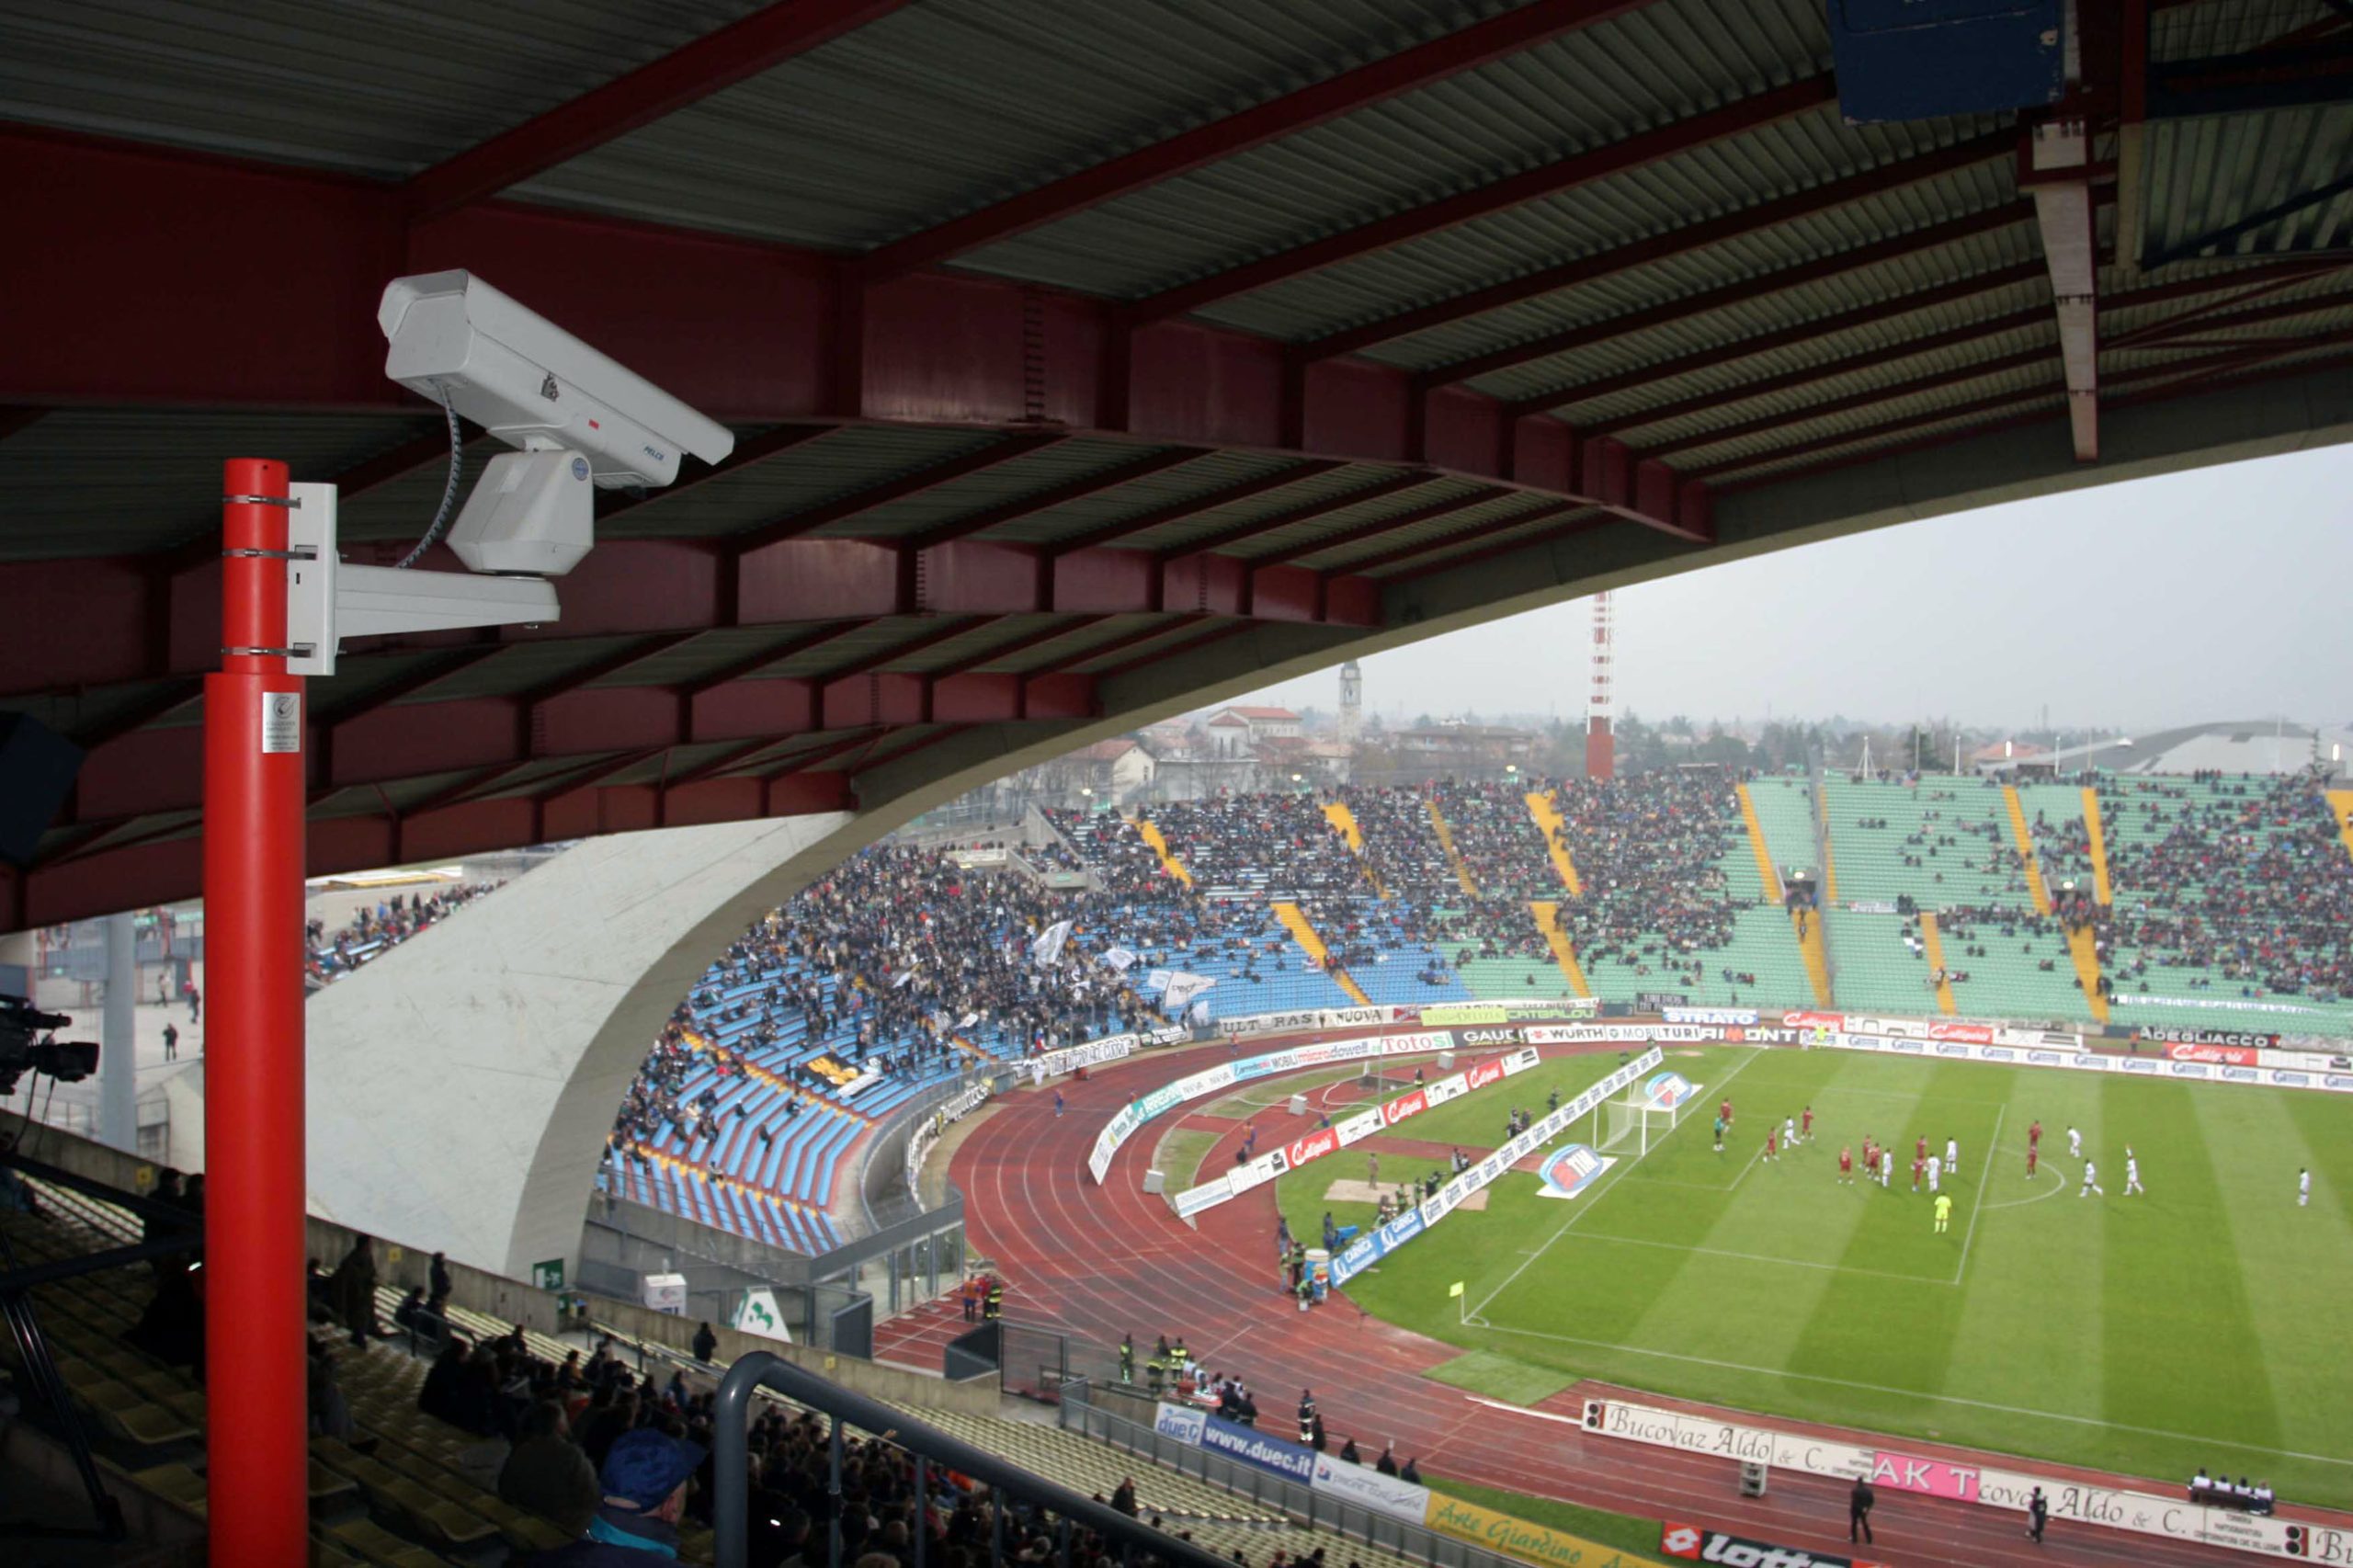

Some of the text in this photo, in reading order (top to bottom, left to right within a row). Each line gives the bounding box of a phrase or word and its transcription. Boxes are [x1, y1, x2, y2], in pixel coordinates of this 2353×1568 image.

[1666, 1012, 1756, 1026] STRATO
[1204, 1426, 1313, 1477] www.duec.it
[1609, 1407, 1707, 1449] Bucovaz
[1713, 1427, 1770, 1460] Aldo
[1805, 1447, 1826, 1471] C.
[1432, 1502, 1582, 1565] Arte Giardino
[2055, 1487, 2123, 1522] Aldo
[2163, 1509, 2186, 1534] C.
[1702, 1533, 1846, 1568] lott
